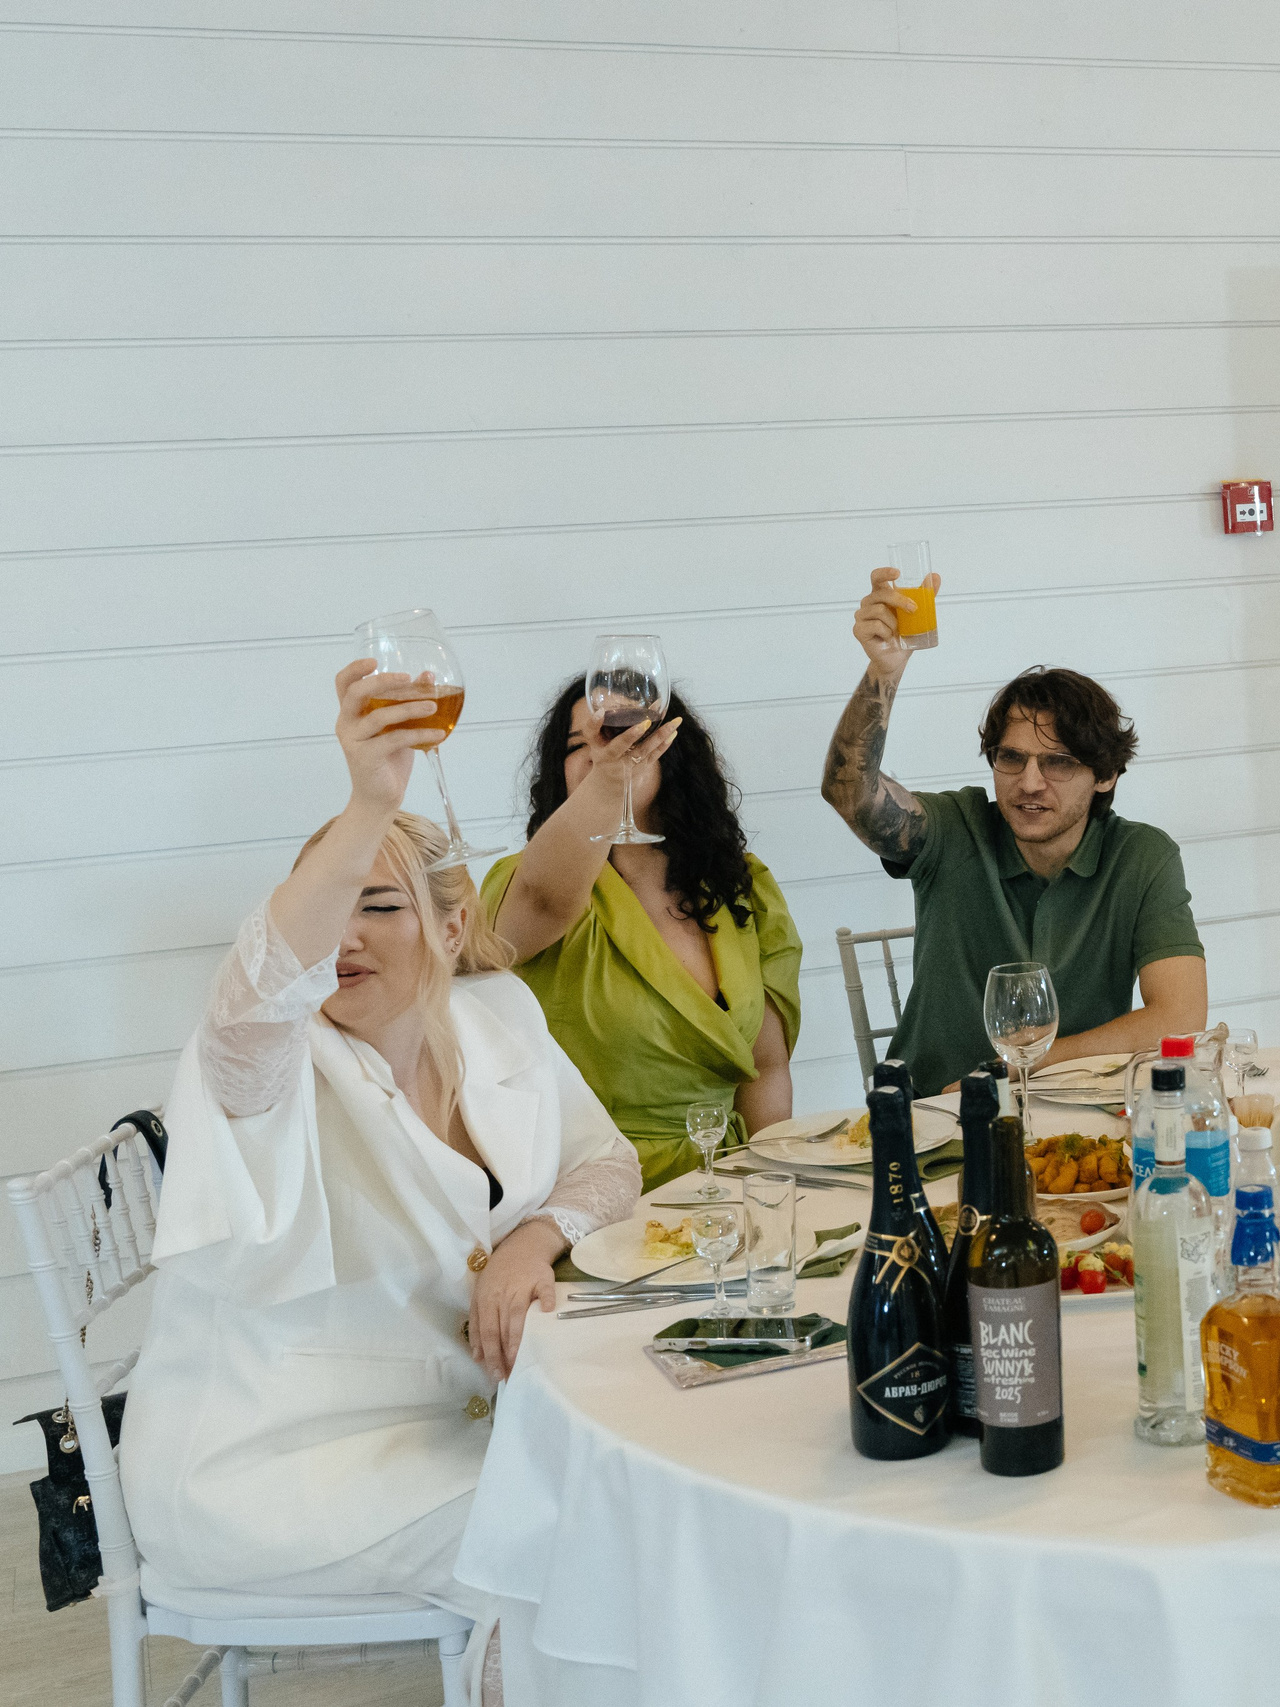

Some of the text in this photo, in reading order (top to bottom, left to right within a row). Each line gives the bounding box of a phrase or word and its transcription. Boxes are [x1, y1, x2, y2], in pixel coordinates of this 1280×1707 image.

[889, 1161, 904, 1204] 1870
[979, 1319, 1034, 1347] BLANC
[1001, 1347, 1036, 1358] wine
[995, 1386, 1022, 1404] 2025
